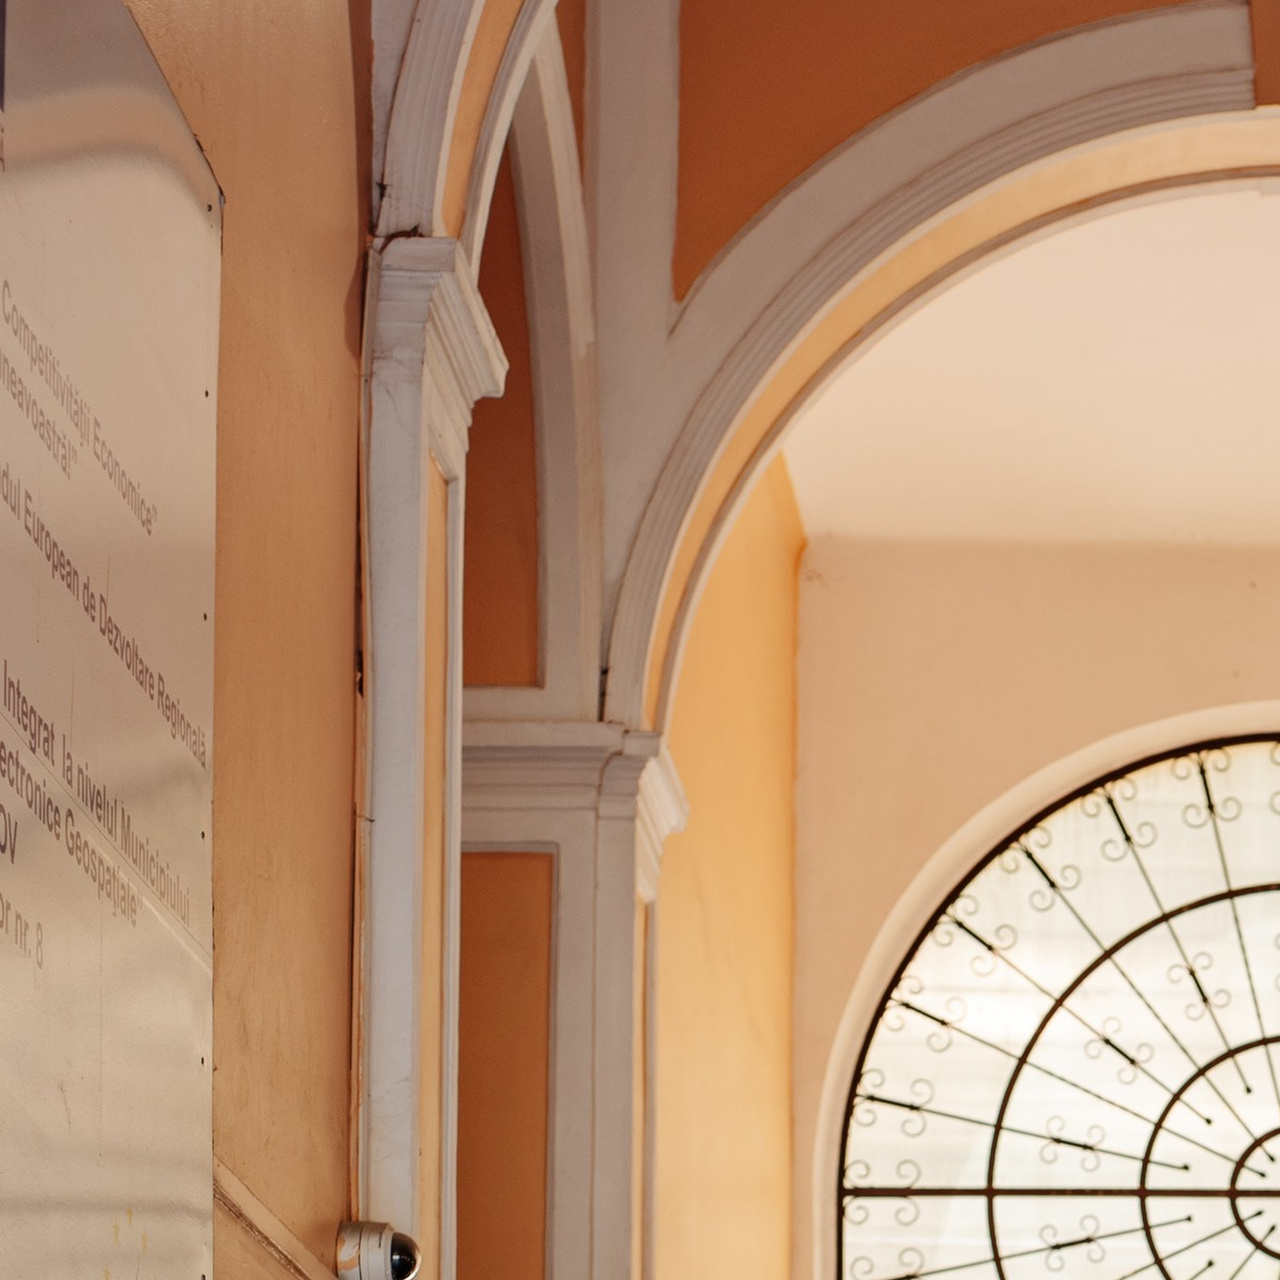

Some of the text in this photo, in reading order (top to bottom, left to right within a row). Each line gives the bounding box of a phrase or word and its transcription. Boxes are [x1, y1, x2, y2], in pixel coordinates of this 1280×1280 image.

[0, 346, 77, 481] neavoastră!”
[2, 462, 206, 770] dul European de Dezvoltare Regională
[0, 740, 61, 841] ectronice
[4, 658, 190, 928] Integrat la nivelul Municipiului
[15, 909, 31, 958] nr.
[35, 921, 44, 970] 8
